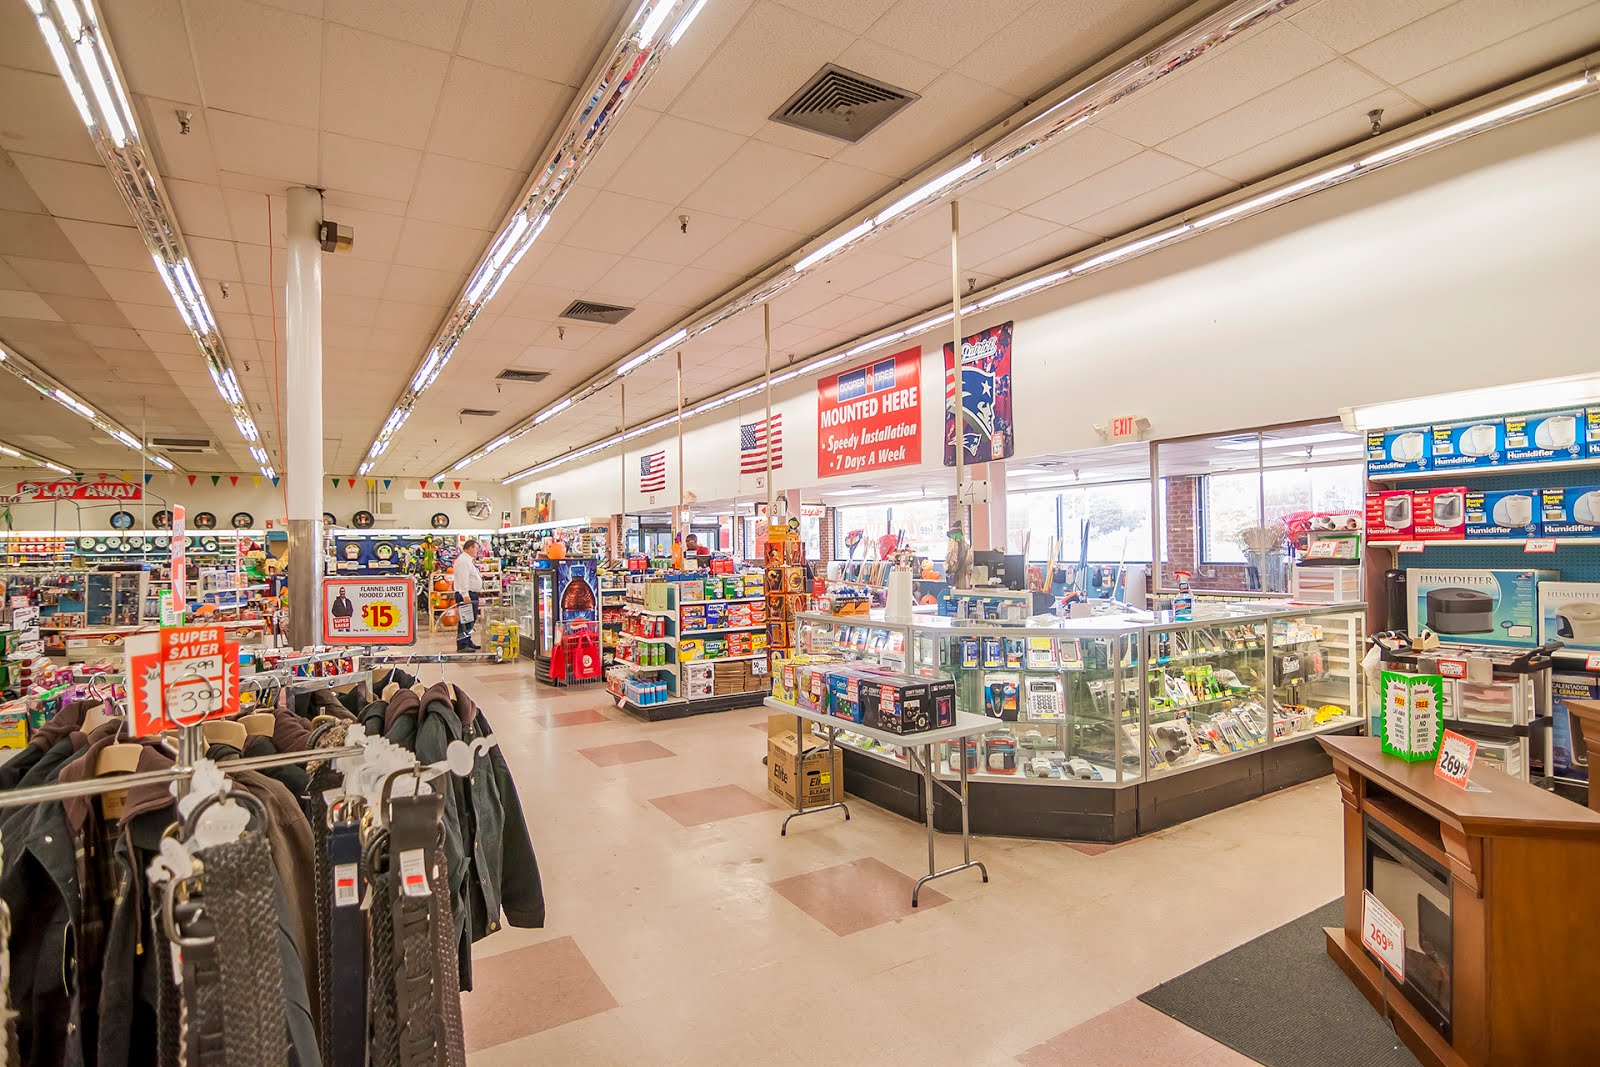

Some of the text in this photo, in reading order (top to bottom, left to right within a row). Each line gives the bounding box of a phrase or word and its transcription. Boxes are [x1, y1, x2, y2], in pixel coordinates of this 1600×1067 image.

[840, 368, 894, 393] COOPER TIRES
[821, 386, 917, 429] MOUNTED HERE
[1113, 417, 1133, 437] EXIT
[827, 422, 917, 454] Speedy Installation
[836, 445, 906, 470] 7 Days A Week
[1434, 456, 1477, 466] Humidifier
[1507, 450, 1555, 460] Humidifier
[1368, 461, 1407, 470] Humidifier
[43, 485, 77, 497] LAY
[85, 484, 138, 497] AWAY
[421, 491, 460, 499] BICYCLES
[964, 482, 976, 503] 4
[773, 504, 778, 515] 3
[1467, 526, 1511, 534] Humidifier
[1544, 525, 1594, 533] Humidifier
[1420, 575, 1493, 585] HUMIDIFIER
[361, 604, 393, 627] $15
[169, 629, 218, 645] SUPER
[169, 643, 219, 659] SAVER
[1552, 682, 1589, 691] CALENTADOR
[1415, 700, 1428, 709] FREE
